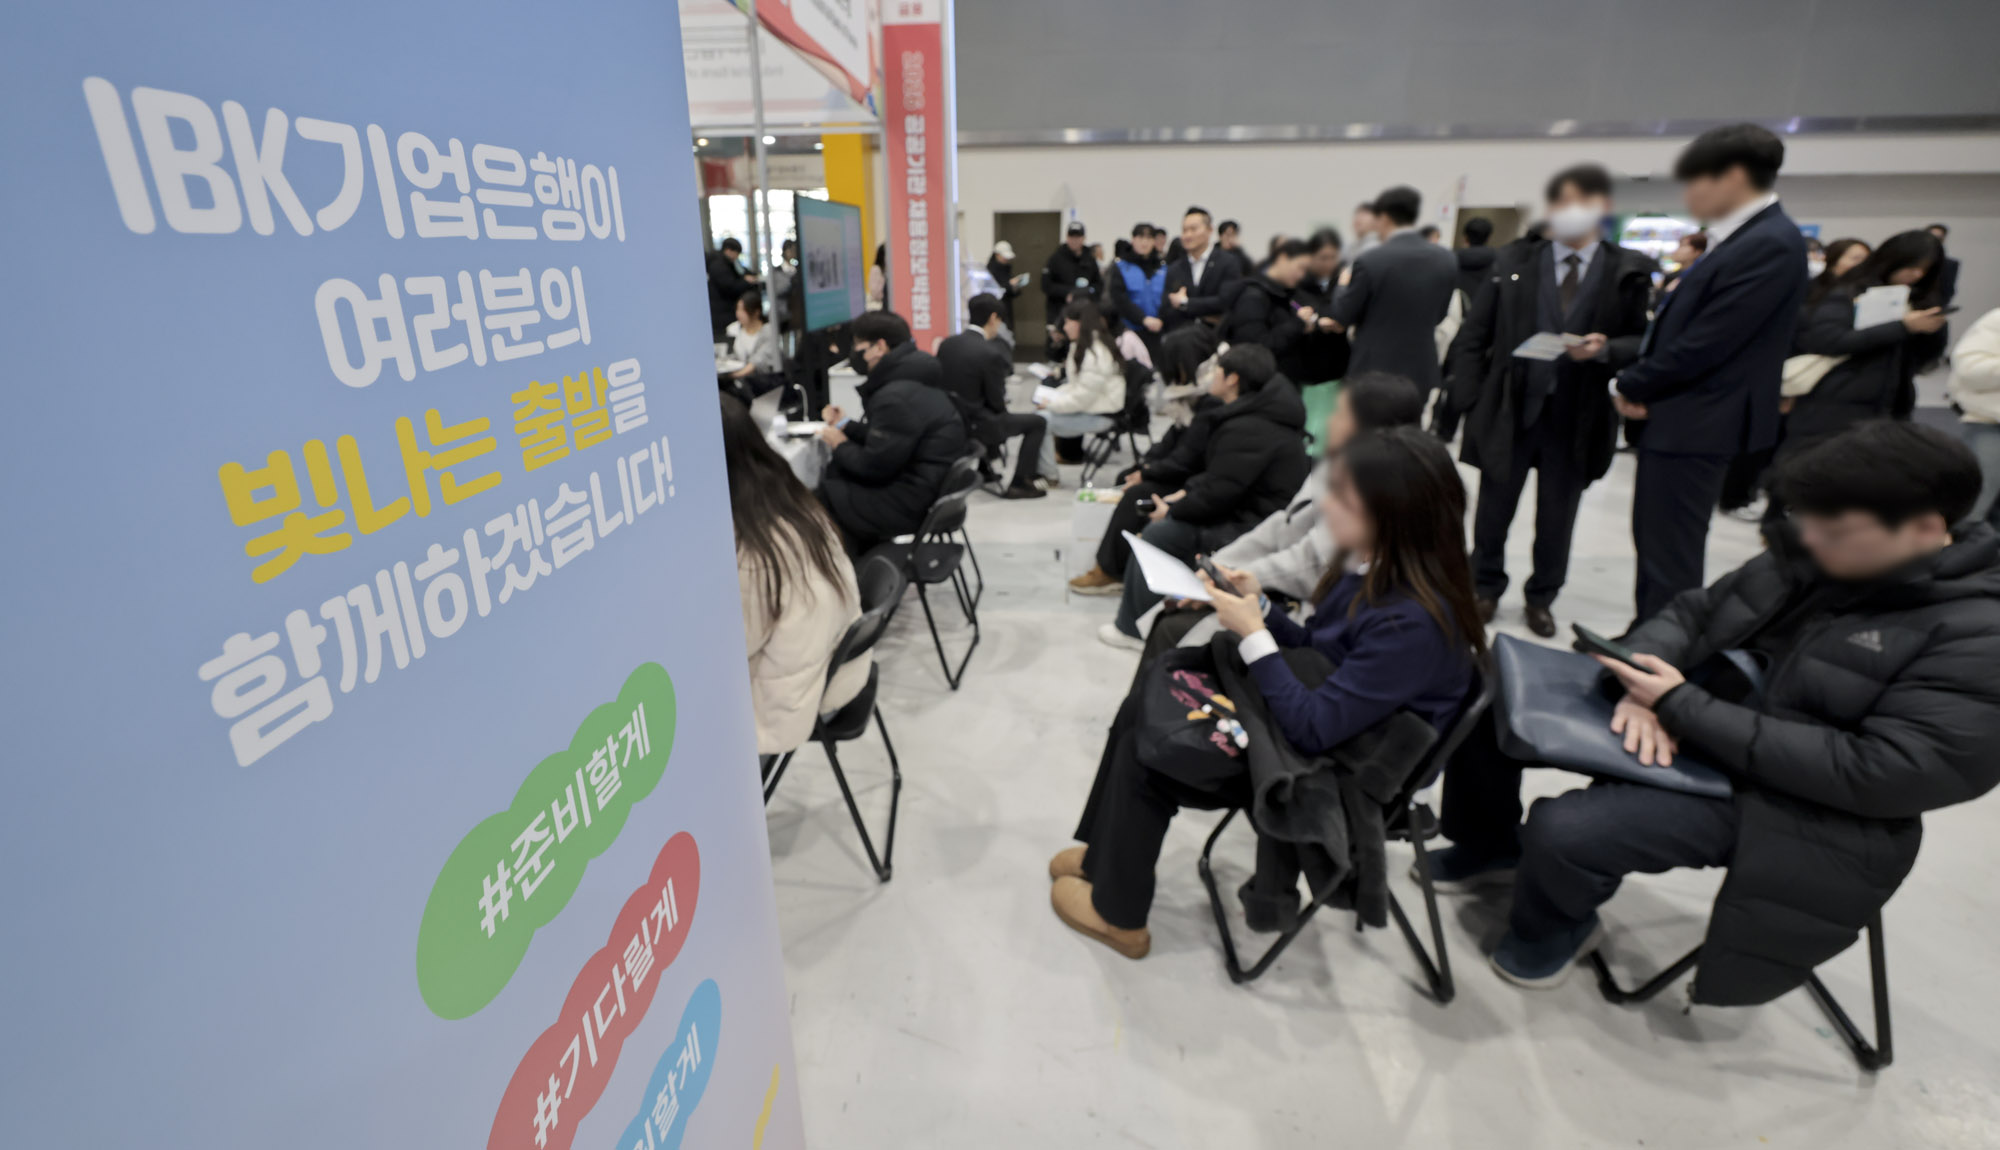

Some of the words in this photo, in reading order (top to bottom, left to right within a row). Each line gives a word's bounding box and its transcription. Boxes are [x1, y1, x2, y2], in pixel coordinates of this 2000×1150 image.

[83, 76, 626, 242] IBK기업은행이
[904, 114, 927, 195] 공공기관
[314, 266, 591, 388] 여러분의
[908, 198, 931, 331] 채용정보박람회
[218, 409, 502, 584] 빛나는
[511, 358, 649, 472] 출발을
[198, 436, 675, 767] 함께하겠습니다!
[479, 702, 650, 939] #준비할게
[533, 877, 679, 1150] #기다릴게
